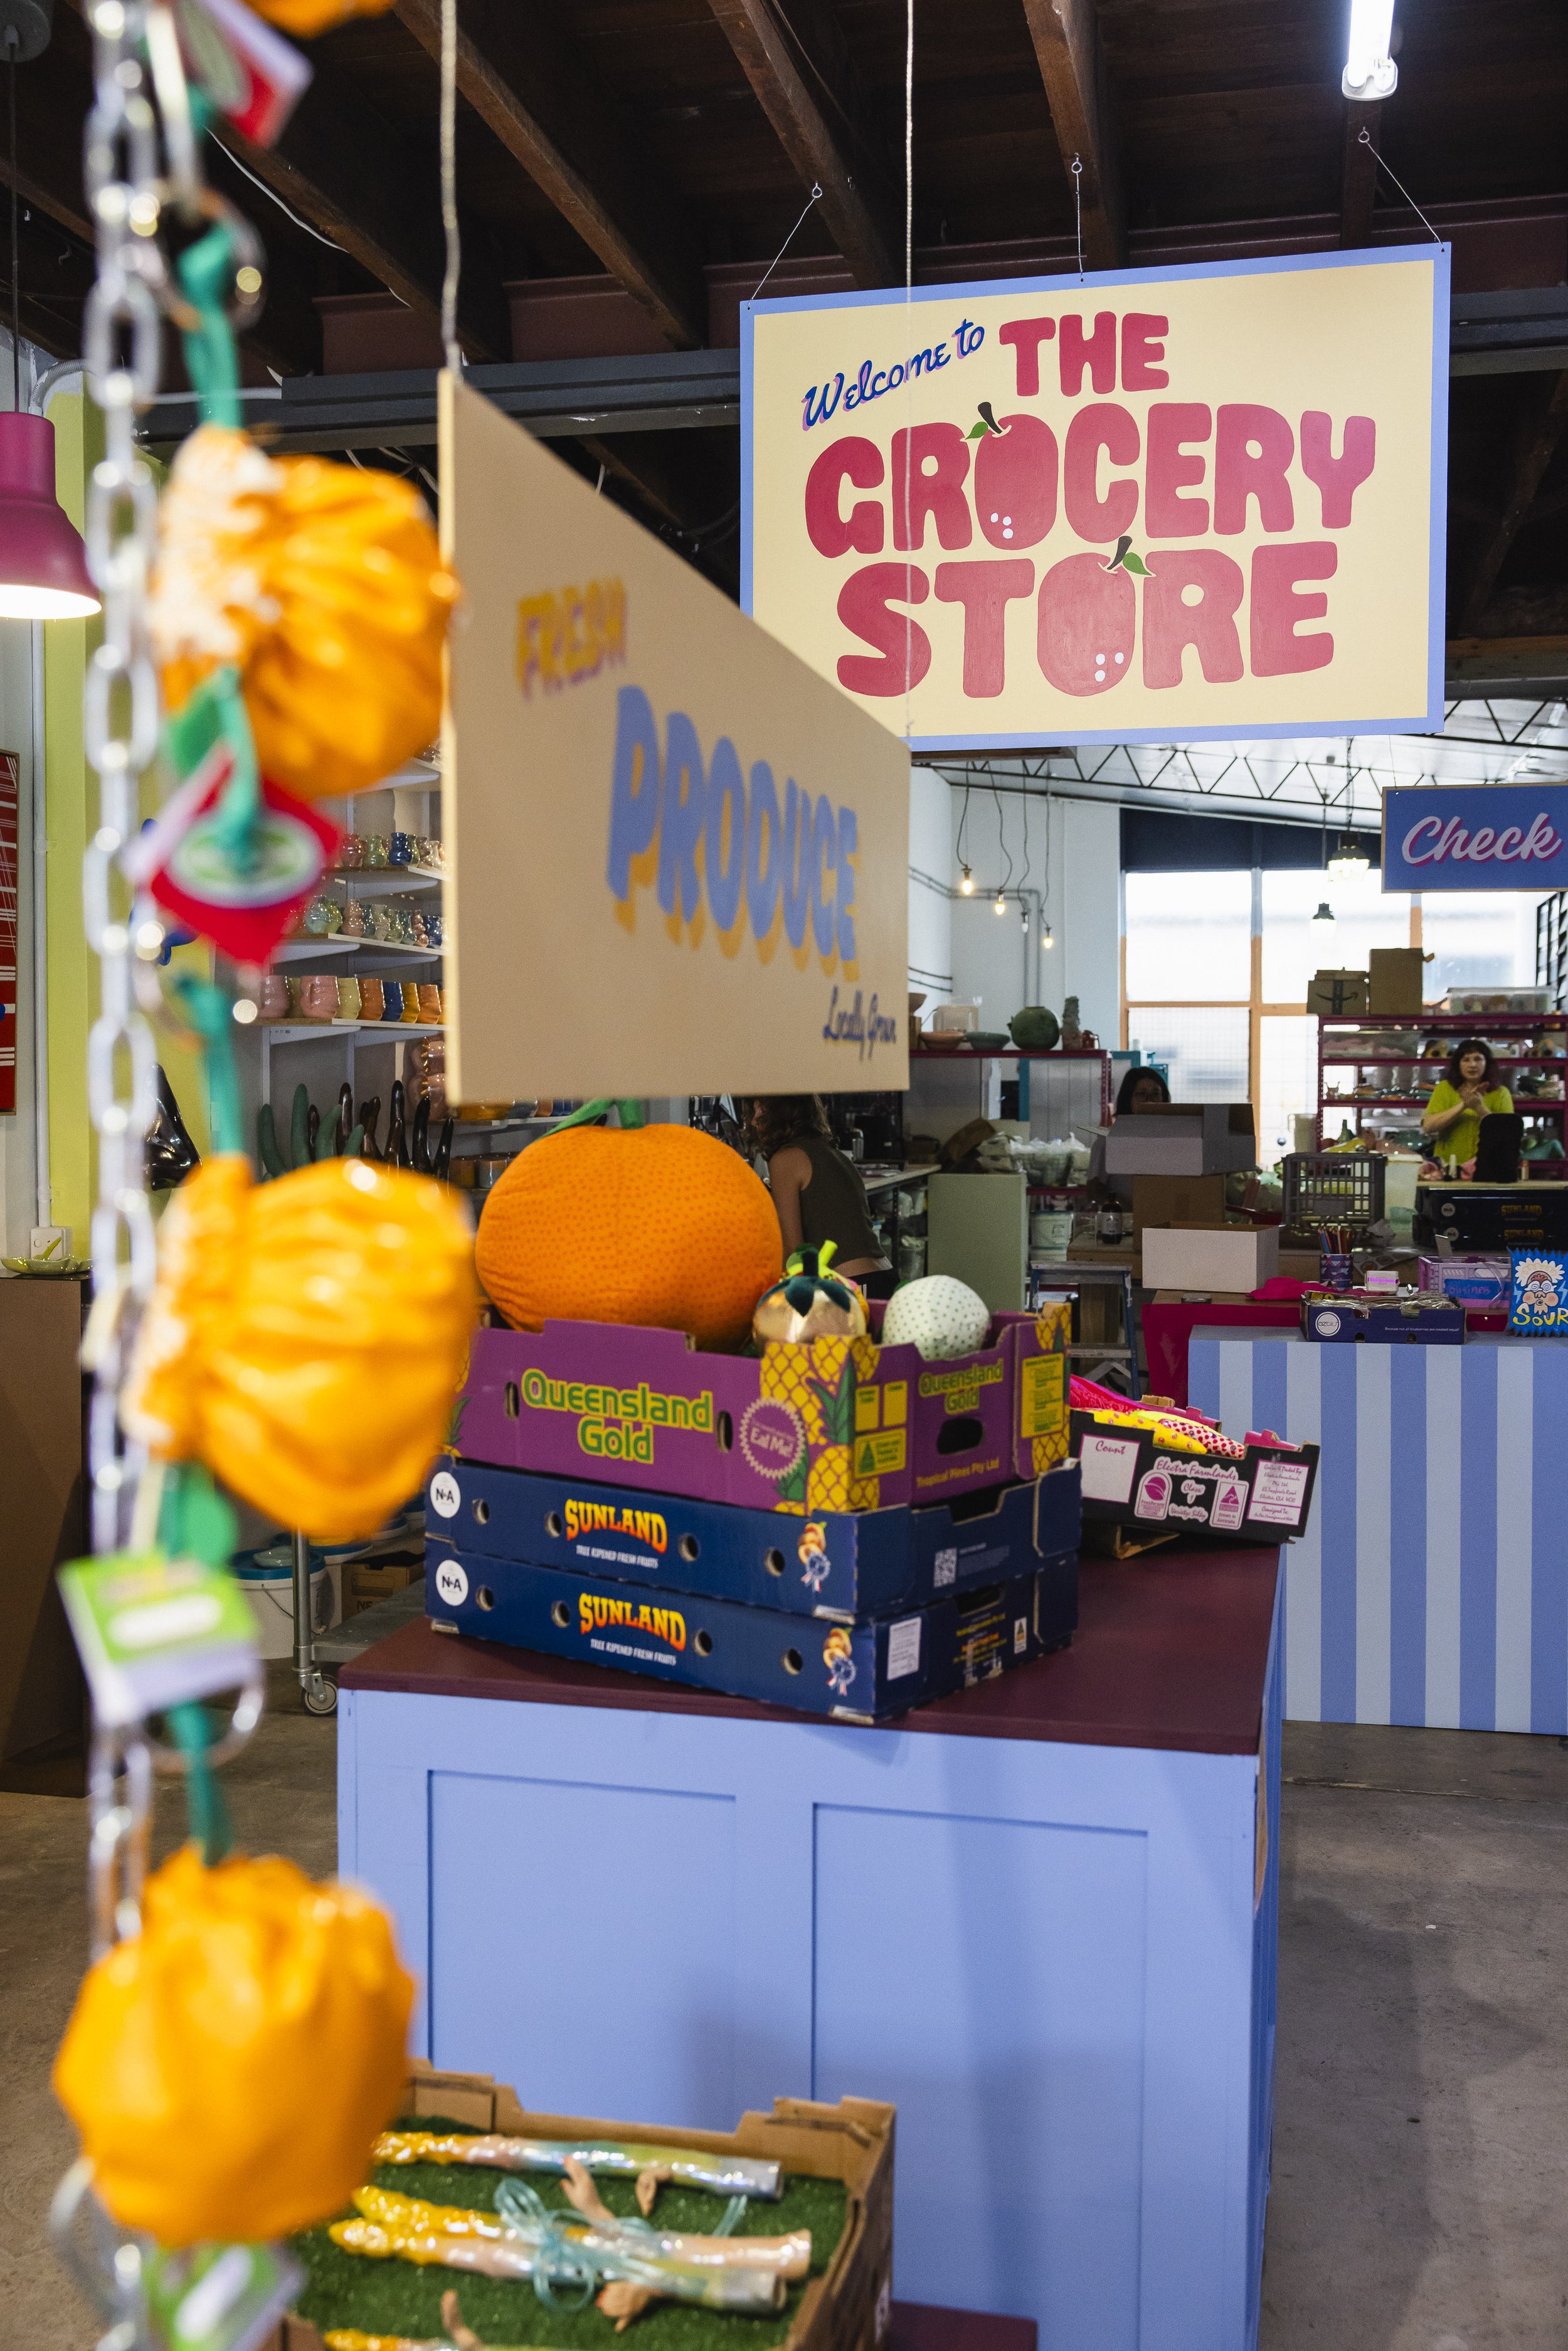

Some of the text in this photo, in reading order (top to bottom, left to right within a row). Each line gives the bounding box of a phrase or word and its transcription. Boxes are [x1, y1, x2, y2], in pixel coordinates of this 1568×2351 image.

[801, 318, 985, 431] Welcome to
[999, 310, 1170, 398] THE
[805, 402, 1375, 558] GROCERY
[837, 536, 1337, 698] STORE
[607, 684, 861, 982] PRODUCE
[1402, 812, 1564, 868] Check
[522, 1368, 713, 1433] Queensland
[918, 1357, 1004, 1398] Queensland
[945, 1387, 980, 1415] Gold
[578, 1416, 654, 1464] Gold
[1096, 1440, 1126, 1455] Count
[1157, 1460, 1237, 1480] Electra Farmlands
[564, 1499, 668, 1554] SUNLAND
[578, 1593, 686, 1652] SUNLAND
